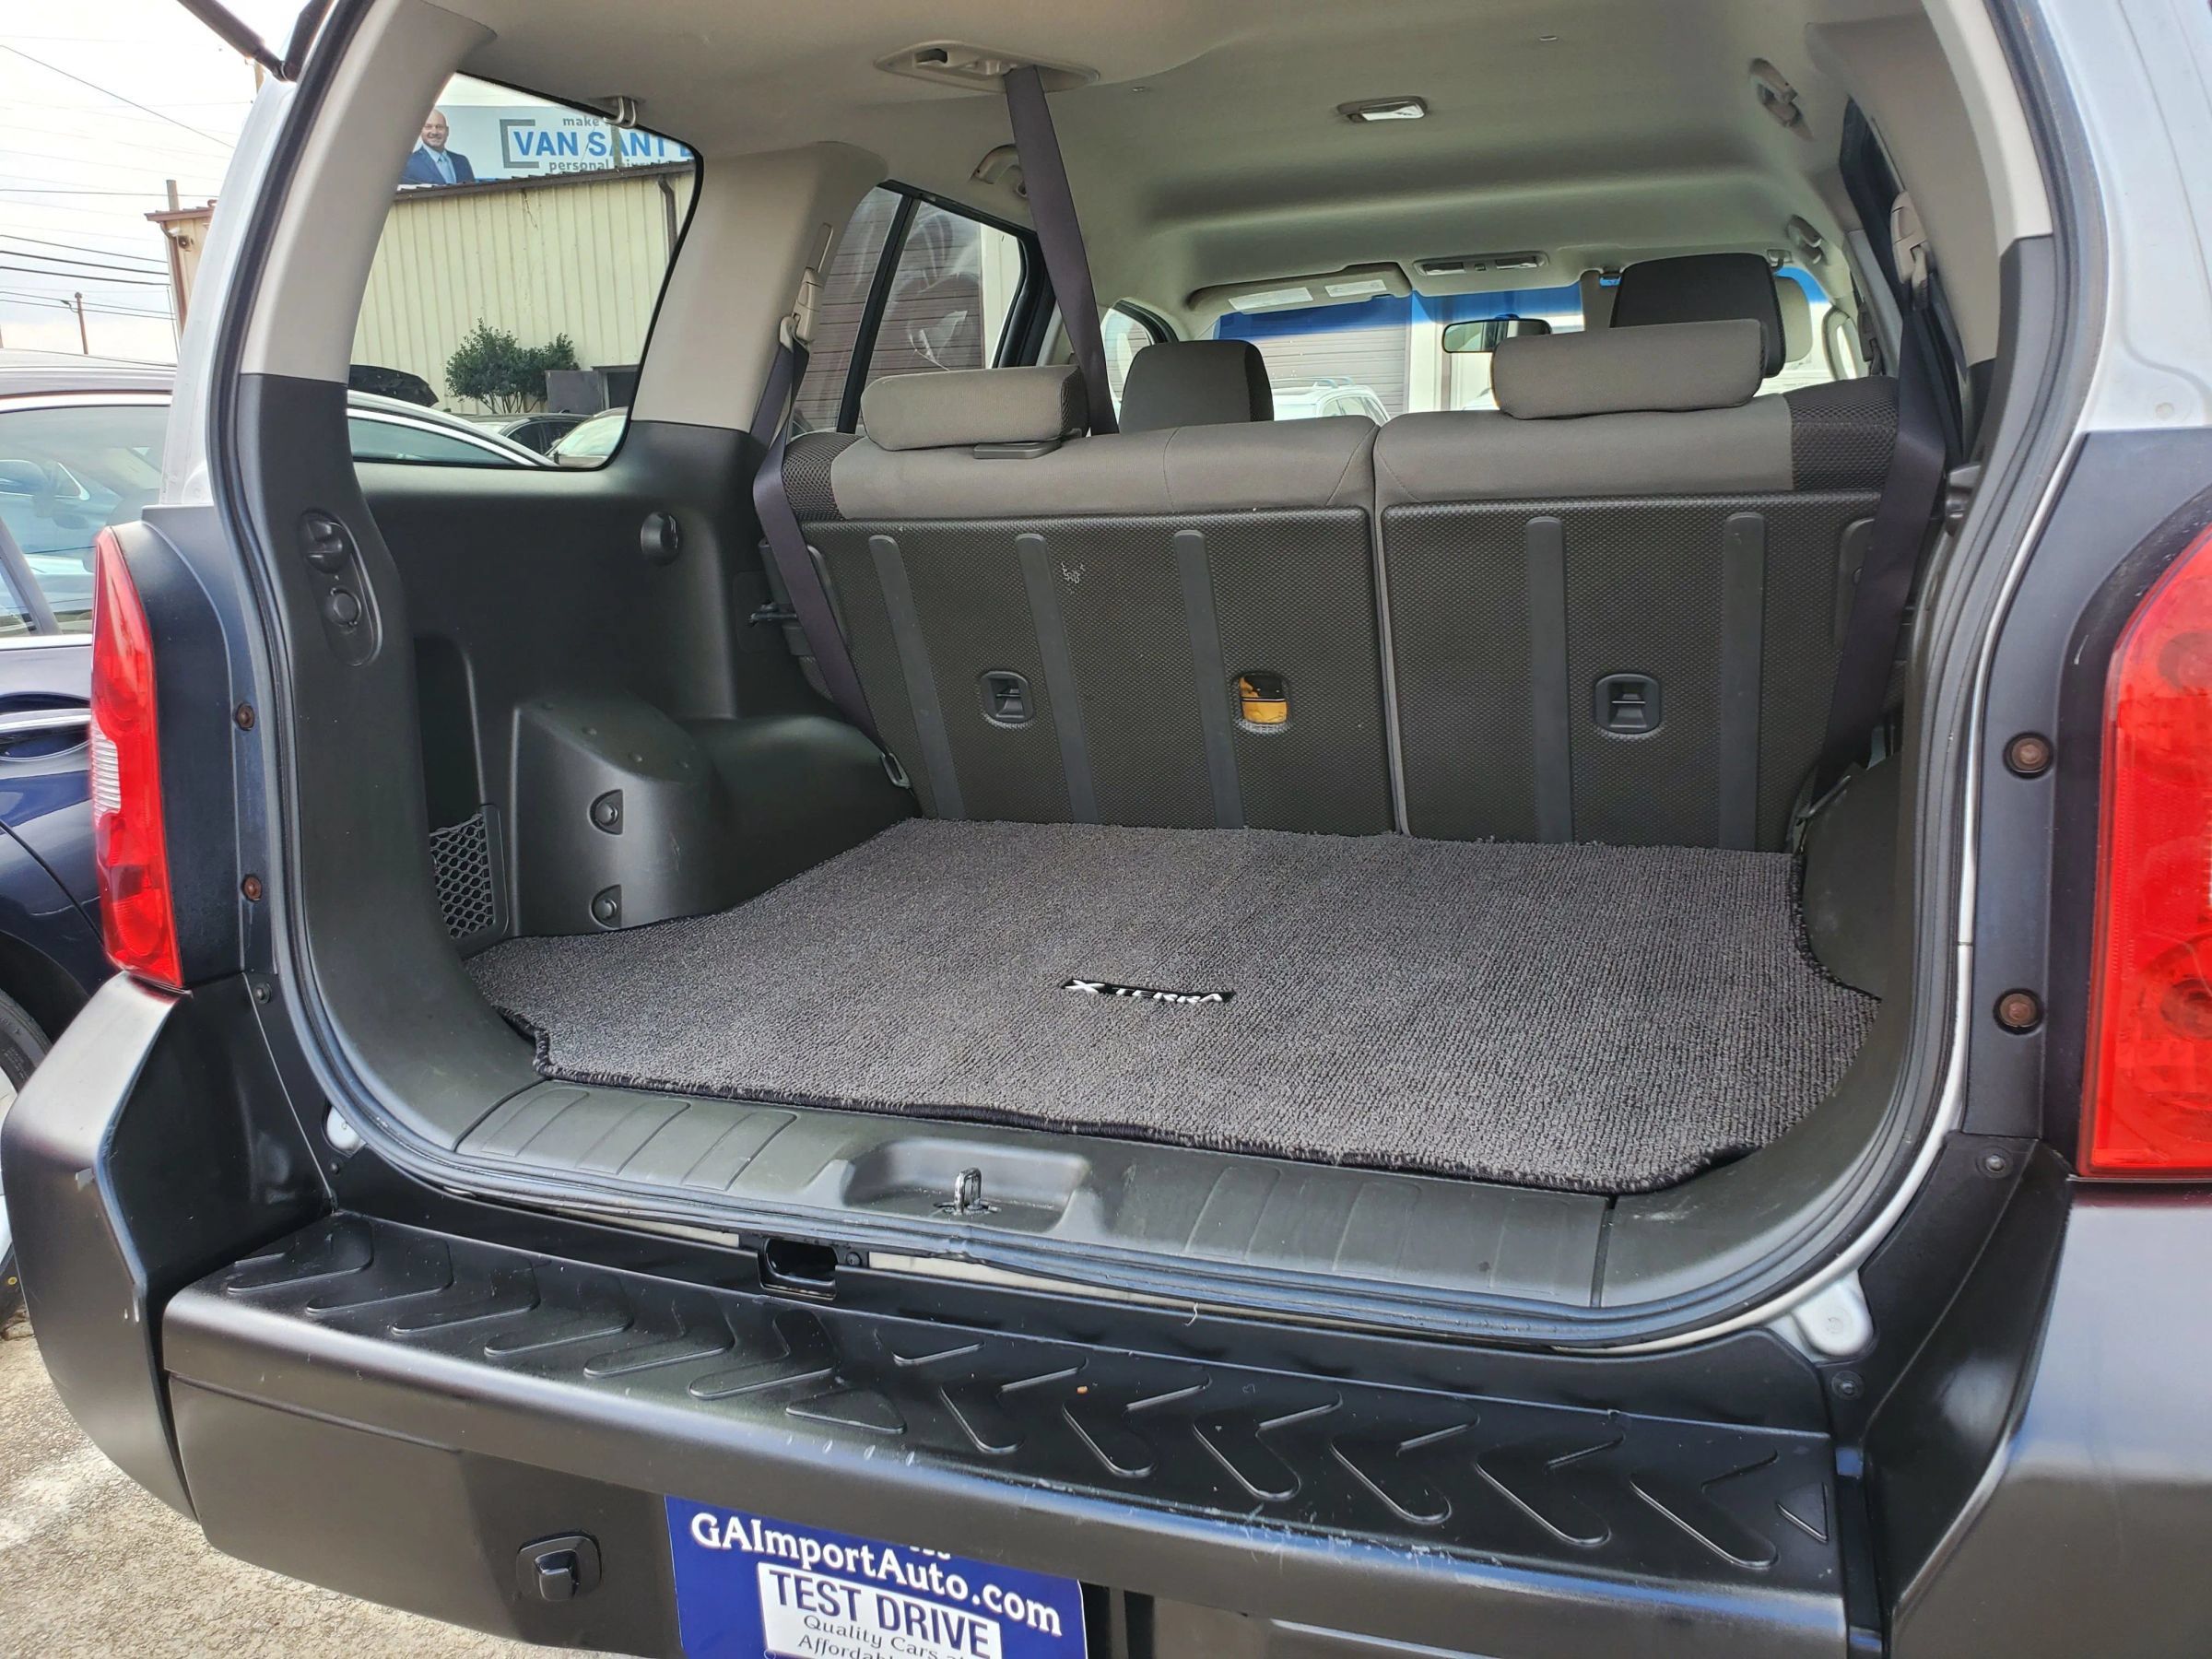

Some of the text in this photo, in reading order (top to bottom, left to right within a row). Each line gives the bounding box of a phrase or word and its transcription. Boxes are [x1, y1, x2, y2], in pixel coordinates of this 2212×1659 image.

[563, 116, 599, 127] make
[513, 131, 579, 157] VAN
[549, 159, 609, 172] personal
[691, 1512, 1063, 1637] GAImportAuto.com
[769, 1569, 989, 1659] TEST DRIVE
[804, 1615, 938, 1659] Quality Cars
